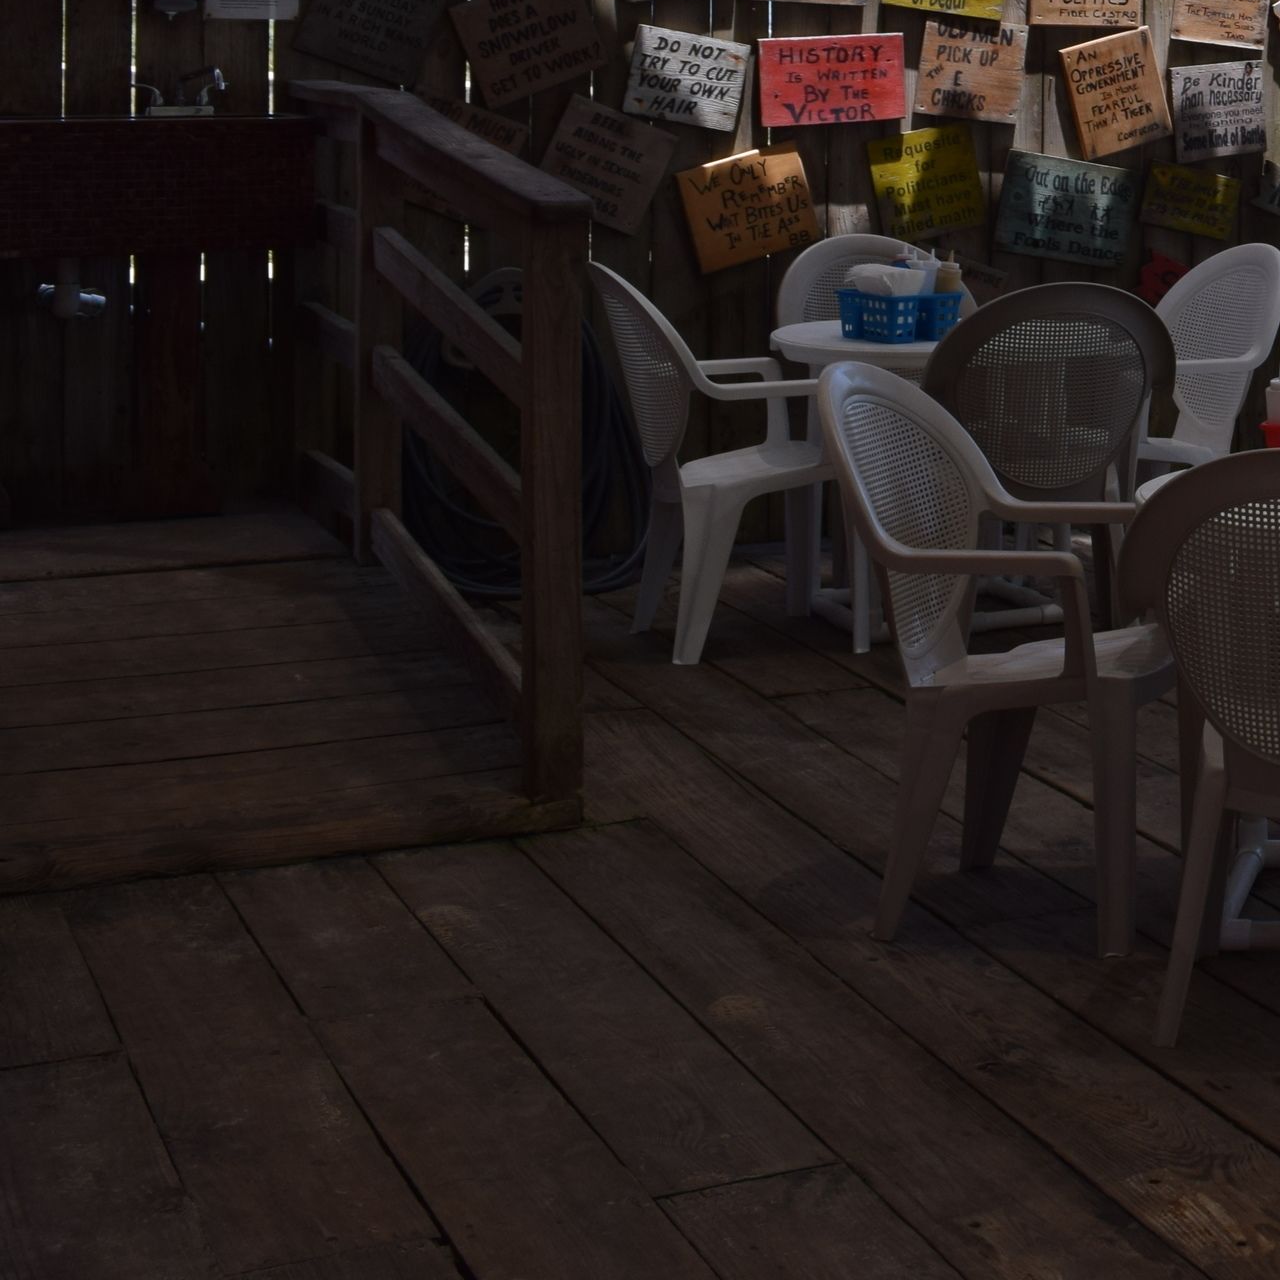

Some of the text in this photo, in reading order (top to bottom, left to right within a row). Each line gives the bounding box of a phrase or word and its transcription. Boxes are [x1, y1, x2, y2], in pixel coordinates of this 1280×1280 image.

[489, 4, 538, 33] DOES A
[1060, 9, 1090, 17] FIDEL
[479, 10, 577, 58] SNOWPLOW
[510, 37, 560, 65] DRIVER
[653, 37, 726, 60] DO NOT
[779, 45, 882, 64] HISTORY
[491, 41, 601, 96] GET TO WORK?
[640, 54, 739, 82] TRY TO CUT
[817, 69, 887, 81] WRITTEN
[639, 73, 730, 100] YOUR OWN
[804, 85, 868, 103] BY THE
[650, 96, 697, 114] HAIR
[783, 103, 875, 123] VICTOR
